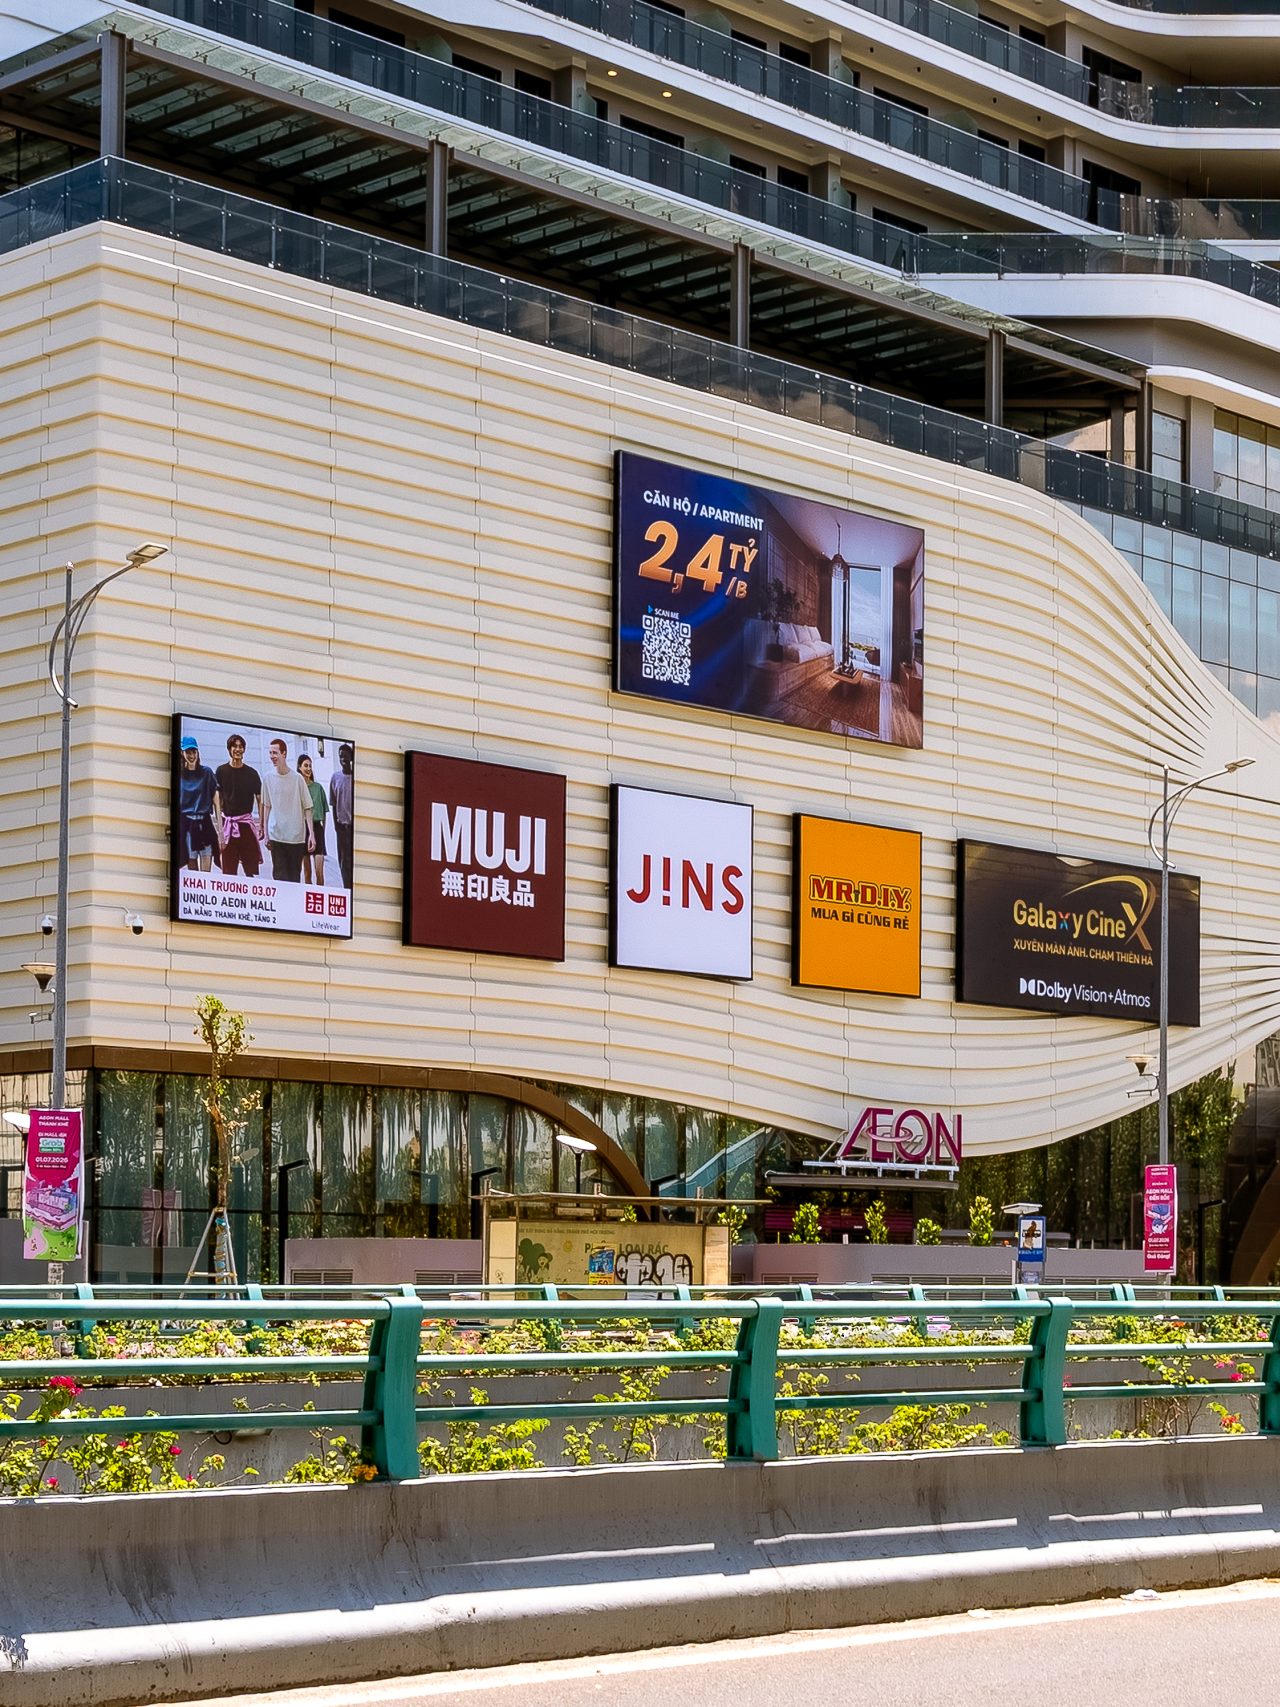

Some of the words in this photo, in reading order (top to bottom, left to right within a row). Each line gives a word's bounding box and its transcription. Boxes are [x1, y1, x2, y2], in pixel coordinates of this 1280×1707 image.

[643, 489, 670, 509] CĂN
[673, 496, 692, 516] HỘ
[699, 504, 764, 531] APARTMENT
[638, 520, 725, 593] 2,4
[430, 801, 547, 876] MUJI
[183, 877, 207, 890] KHAI
[252, 885, 277, 898] 03.07
[440, 867, 535, 908] 無印良品
[183, 892, 220, 906] UNIQLO
[220, 896, 247, 909] AEON
[250, 900, 276, 912] MALL
[329, 896, 344, 906] UNI
[329, 905, 345, 915] QLO
[214, 909, 237, 920] THANH
[272, 916, 277, 924] 2
[311, 920, 340, 931] LifeWear
[811, 906, 840, 921] MUA
[842, 908, 854, 923] GÌ
[857, 911, 891, 928] CŨNG
[1013, 899, 1084, 939] Galaxy
[1013, 938, 1044, 953] XUYÊN
[1045, 942, 1066, 956] MÀN
[1089, 949, 1115, 963] CHẠM
[1116, 951, 1140, 966] THIÊN
[1037, 979, 1072, 1003] Dolby
